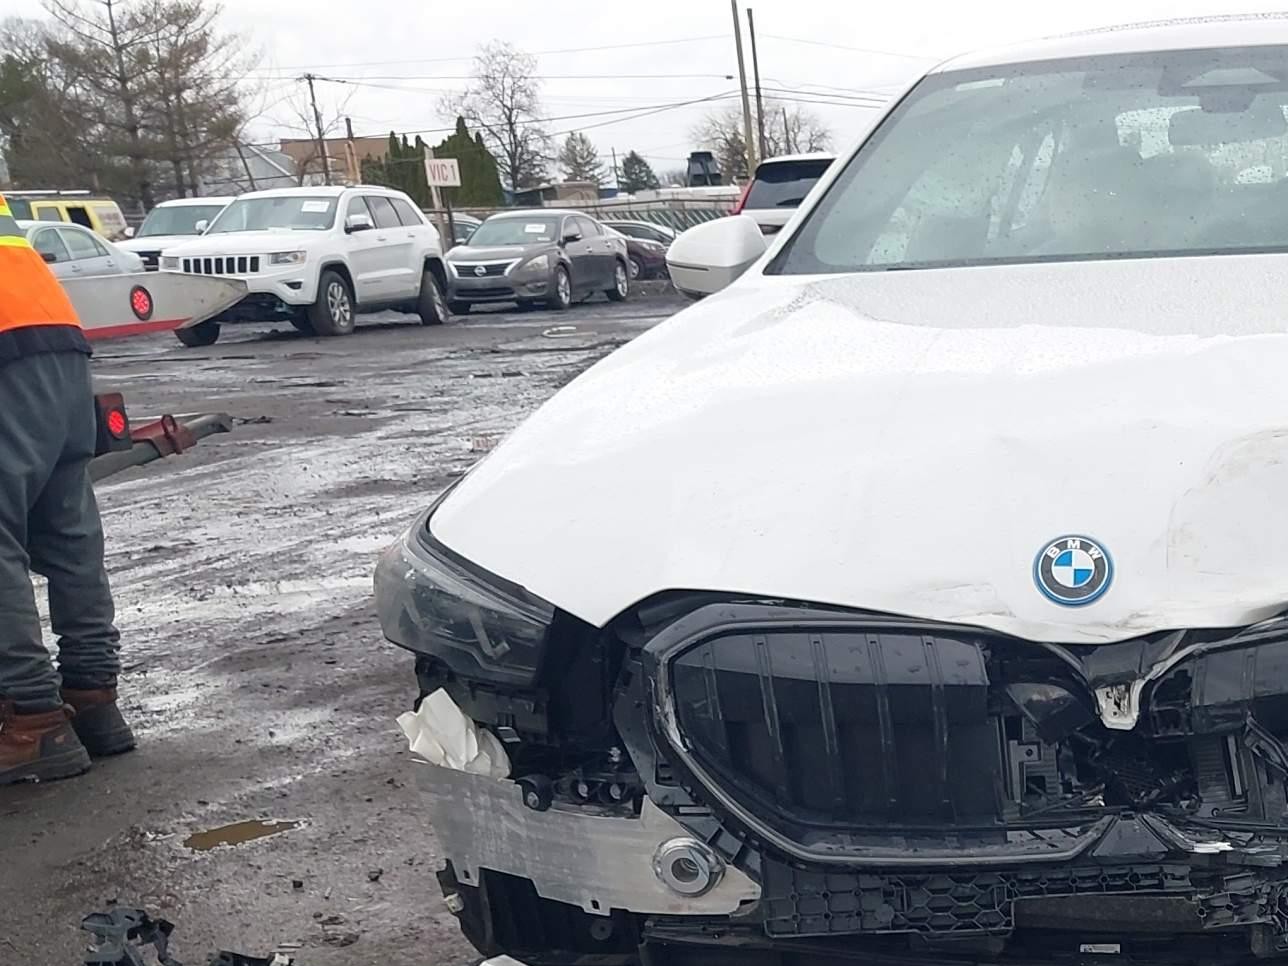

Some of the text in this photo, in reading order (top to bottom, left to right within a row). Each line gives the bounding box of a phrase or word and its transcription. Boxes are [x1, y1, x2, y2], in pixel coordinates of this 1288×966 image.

[430, 164, 457, 182] VIC 1
[1046, 539, 1102, 560] BMW
